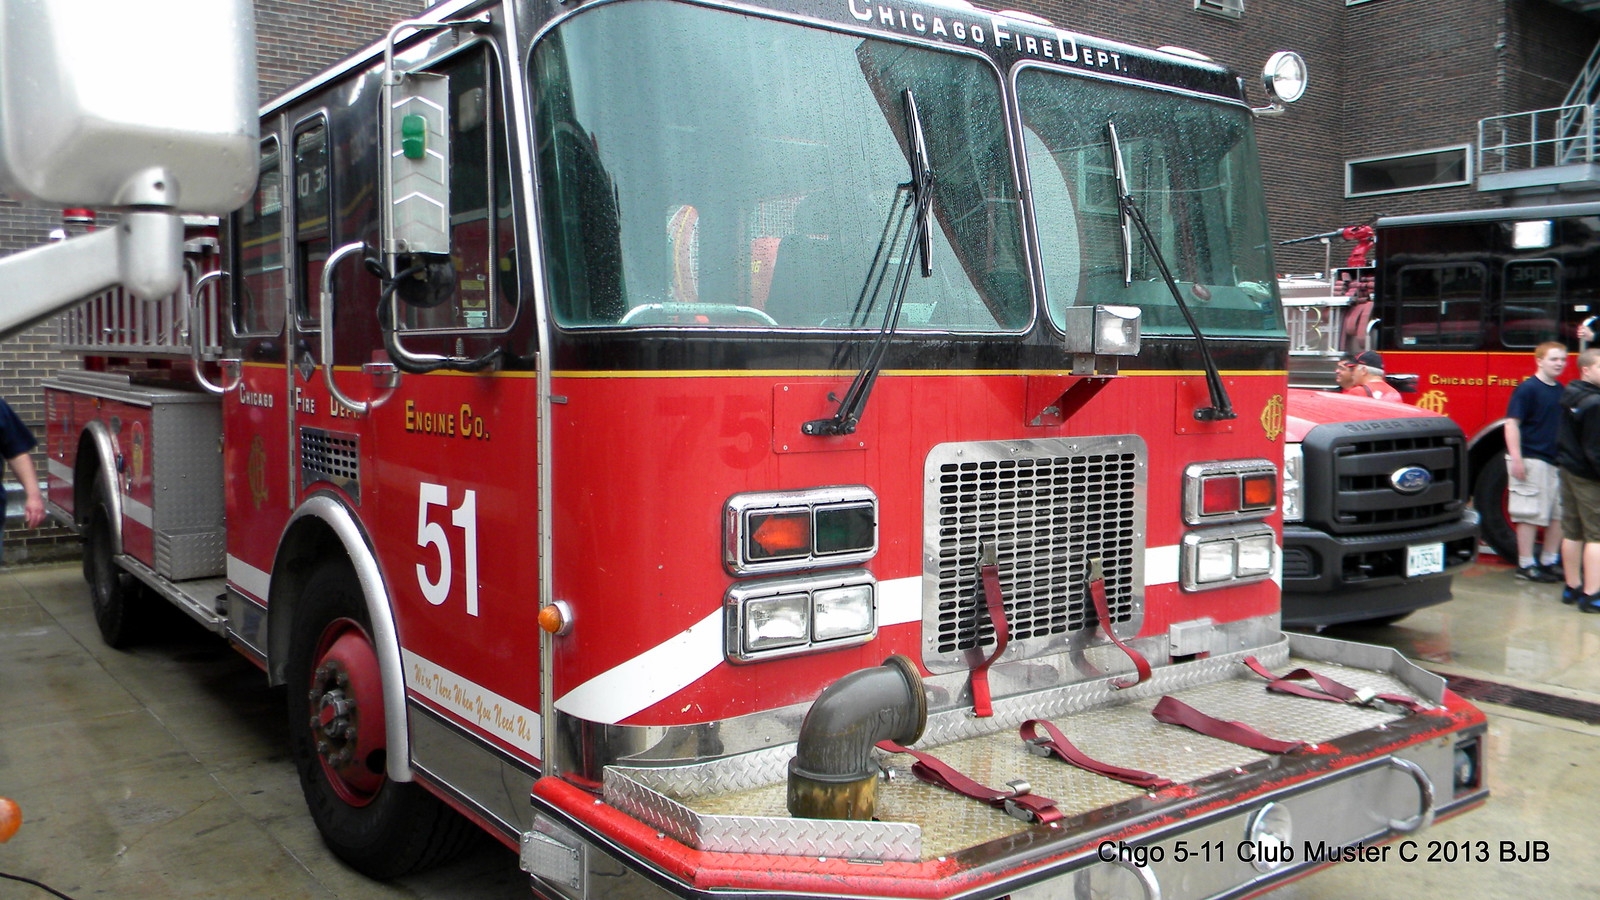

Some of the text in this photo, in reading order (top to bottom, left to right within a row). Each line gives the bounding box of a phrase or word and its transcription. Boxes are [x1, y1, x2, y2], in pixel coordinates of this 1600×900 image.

[848, 0, 1129, 72] CHICAGO FIRE DEPT.
[239, 382, 274, 409] CHICAGO
[295, 387, 316, 414] FIRE
[1429, 374, 1484, 386] CHICAGO
[1487, 374, 1519, 387] FIRE
[405, 400, 455, 435] ENGINE
[416, 481, 479, 617] 51
[433, 674, 452, 700] There
[453, 684, 474, 712] When
[475, 695, 492, 725] You
[493, 703, 515, 733] Need
[517, 715, 532, 742] Us
